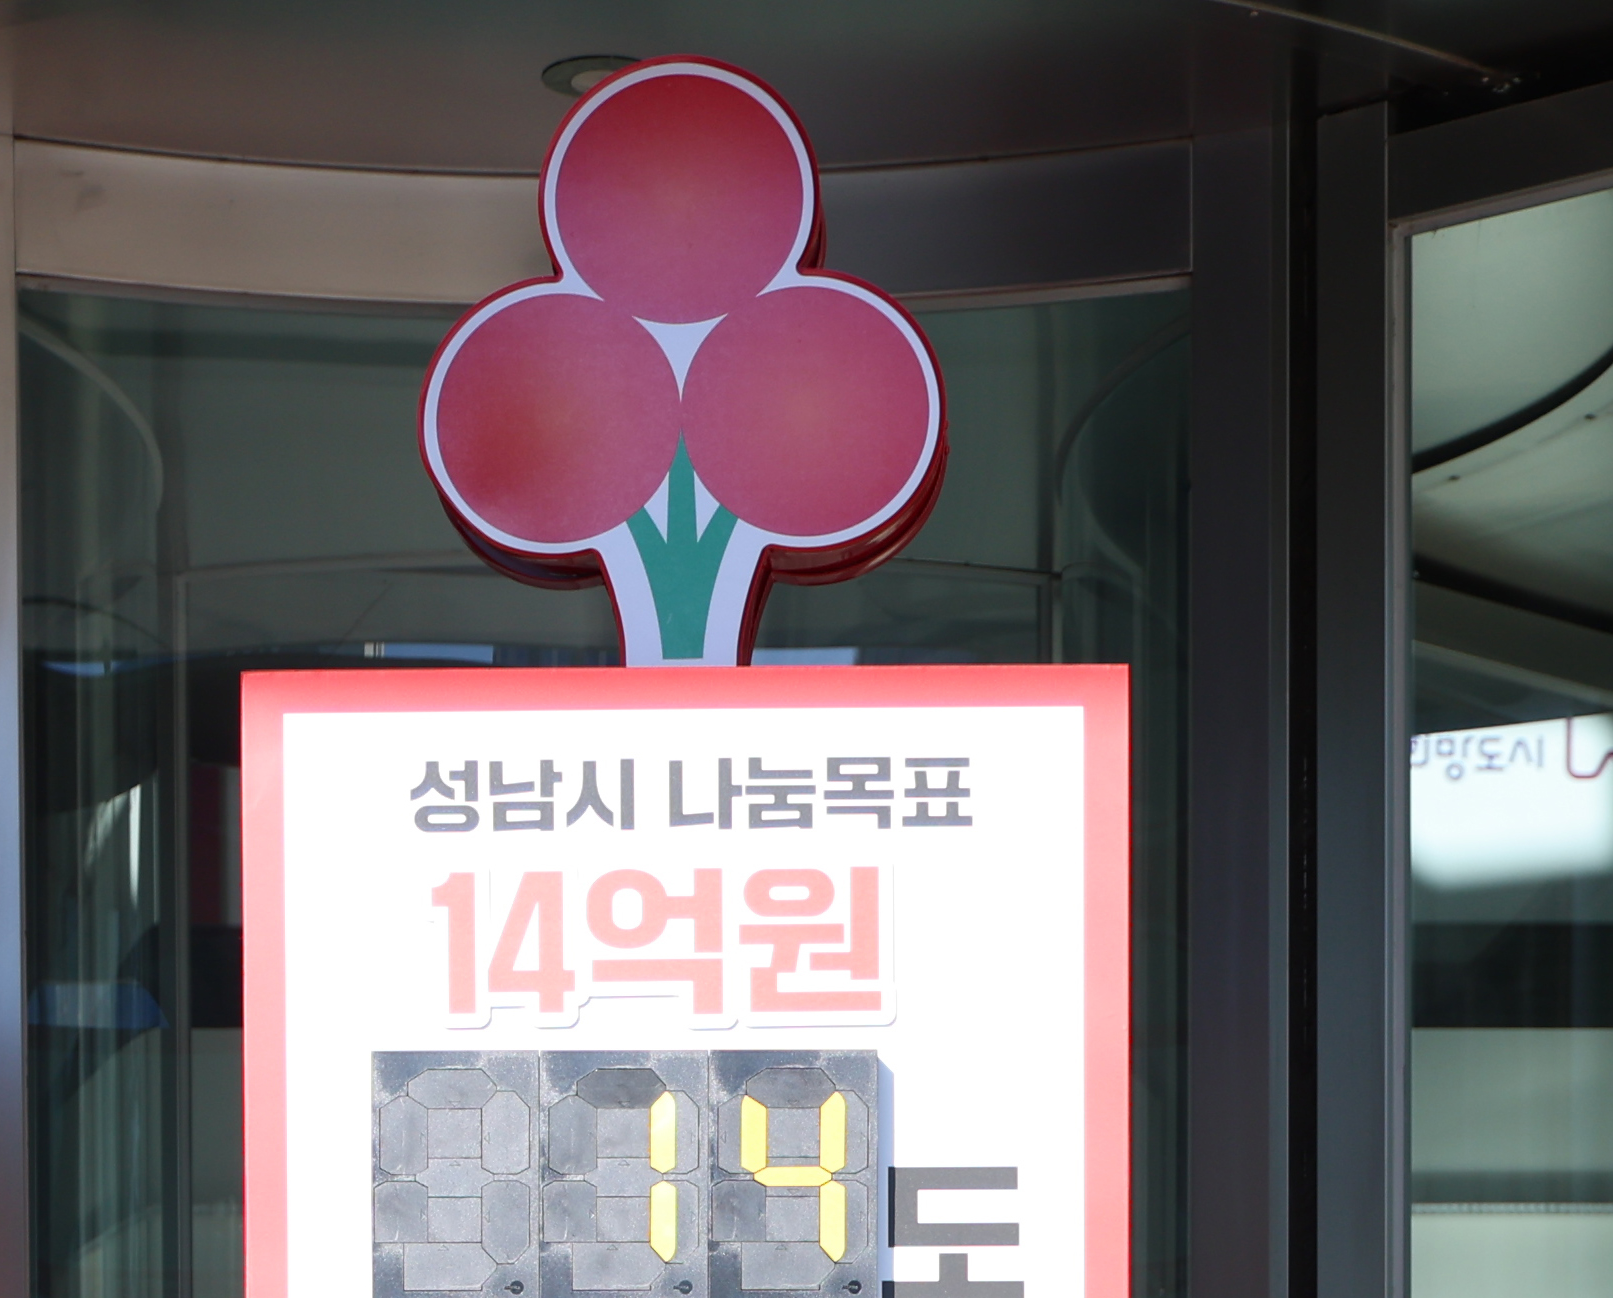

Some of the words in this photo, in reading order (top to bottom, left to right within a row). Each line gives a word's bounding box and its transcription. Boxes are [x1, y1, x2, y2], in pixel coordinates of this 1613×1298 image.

[410, 757, 634, 832] 성남시
[668, 756, 973, 831] 나눔목표
[430, 866, 882, 1015] 14억원
[649, 1090, 847, 1264] 14
